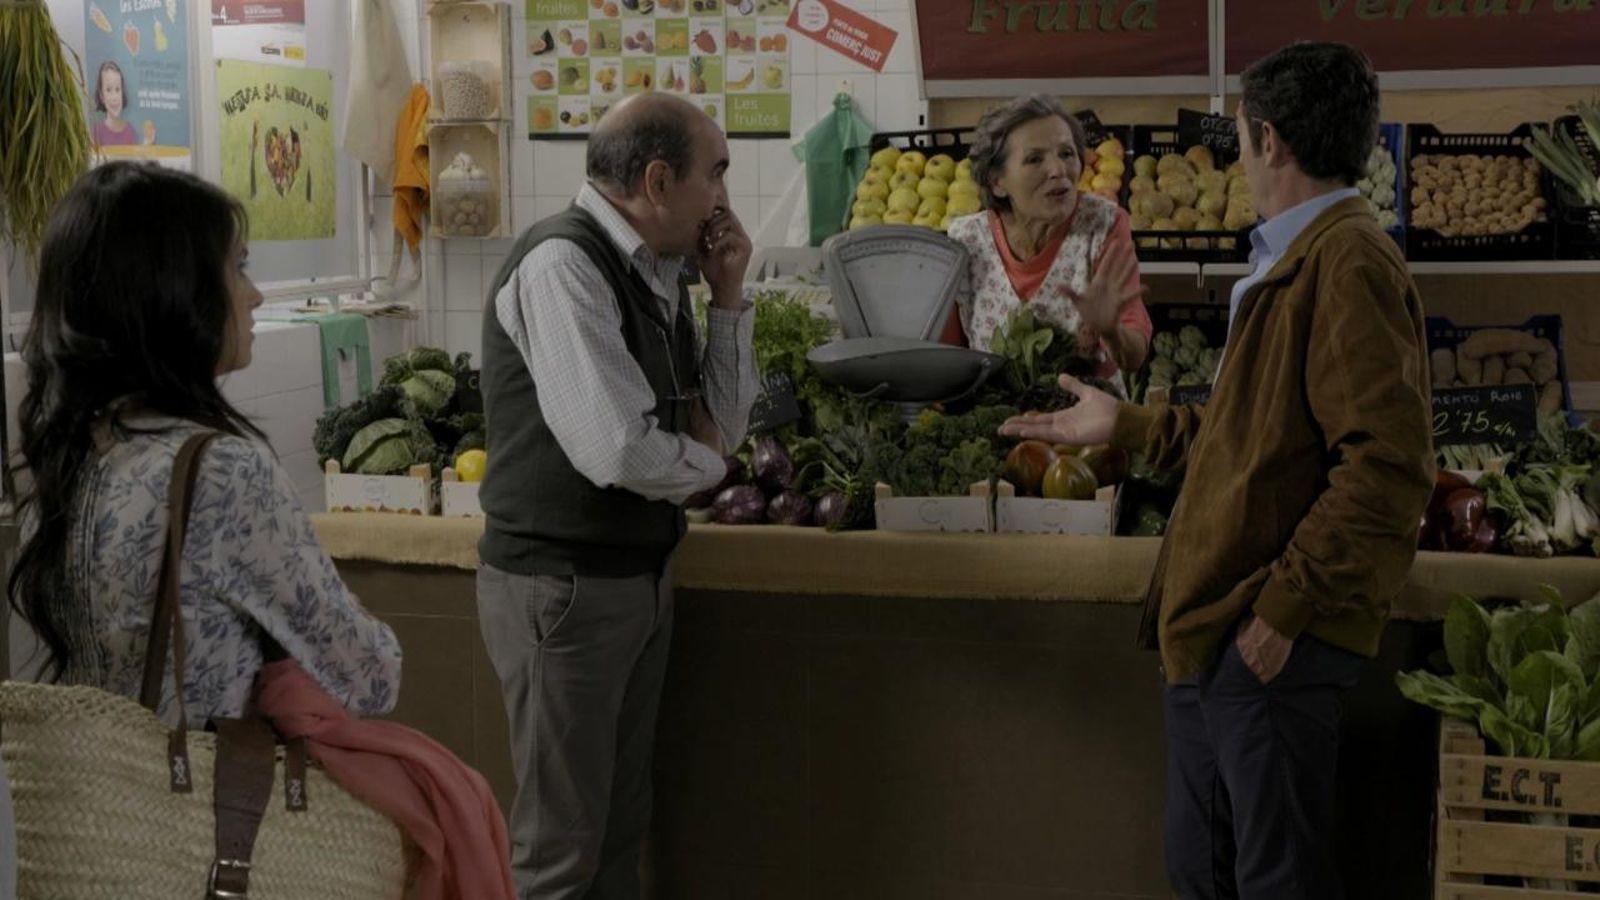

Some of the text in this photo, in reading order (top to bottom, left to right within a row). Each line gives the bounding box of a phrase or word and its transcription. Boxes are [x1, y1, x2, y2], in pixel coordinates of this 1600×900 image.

[965, 0, 1160, 33] Fruita
[734, 98, 758, 110] Les
[735, 112, 780, 127] fruites
[1482, 764, 1562, 807] E.C.T.
